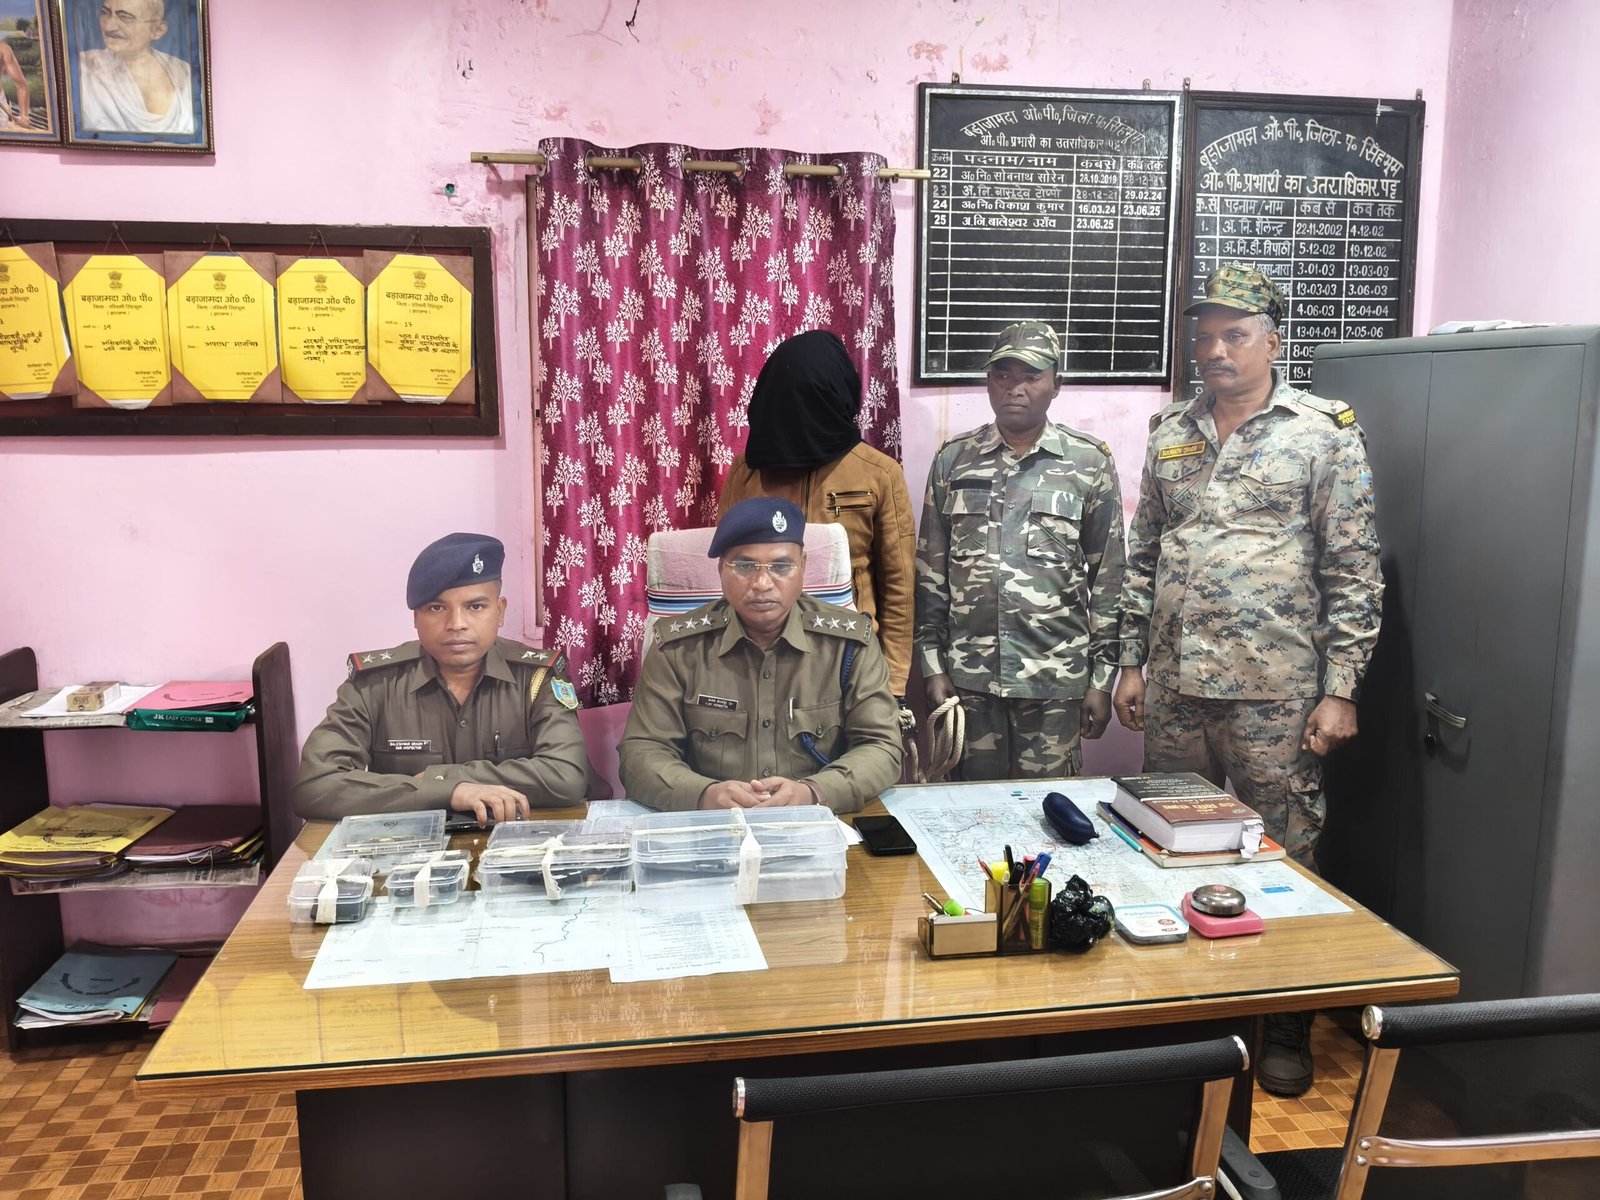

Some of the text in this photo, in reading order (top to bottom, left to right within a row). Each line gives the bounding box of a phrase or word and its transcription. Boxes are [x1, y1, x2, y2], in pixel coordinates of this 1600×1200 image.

[1039, 137, 1052, 148] का
[932, 168, 948, 178] 22
[1283, 174, 1308, 194] का
[932, 184, 948, 197] 23
[1124, 190, 1162, 200] 29.02.24
[932, 200, 948, 209] 24
[1036, 202, 1065, 213] कुमार
[1078, 204, 1116, 214] 16.03.24
[1123, 205, 1160, 216] 23.06.25
[1300, 201, 1322, 215] कब
[1325, 200, 1337, 215] से
[1352, 202, 1375, 217] कब
[1377, 203, 1398, 217] तक
[933, 214, 947, 225] 25
[1076, 218, 1114, 229] 23.06.25
[1295, 222, 1343, 236] 22.11.2002
[1349, 224, 1384, 237] 4.12.02
[1298, 241, 1336, 255] 5.12.02
[1349, 243, 1387, 257] 19.12.02
[1297, 261, 1335, 276] 3.01.03
[1348, 264, 1389, 278] 13.03.03
[1296, 281, 1337, 296] 13.03.03
[1347, 283, 1388, 296] 3.06.03
[1296, 303, 1389, 317] 4.06.03 12.04.04
[1296, 326, 1337, 338] 13.04.04
[1345, 326, 1384, 338] 7.05.06
[165, 714, 179, 722] EASY
